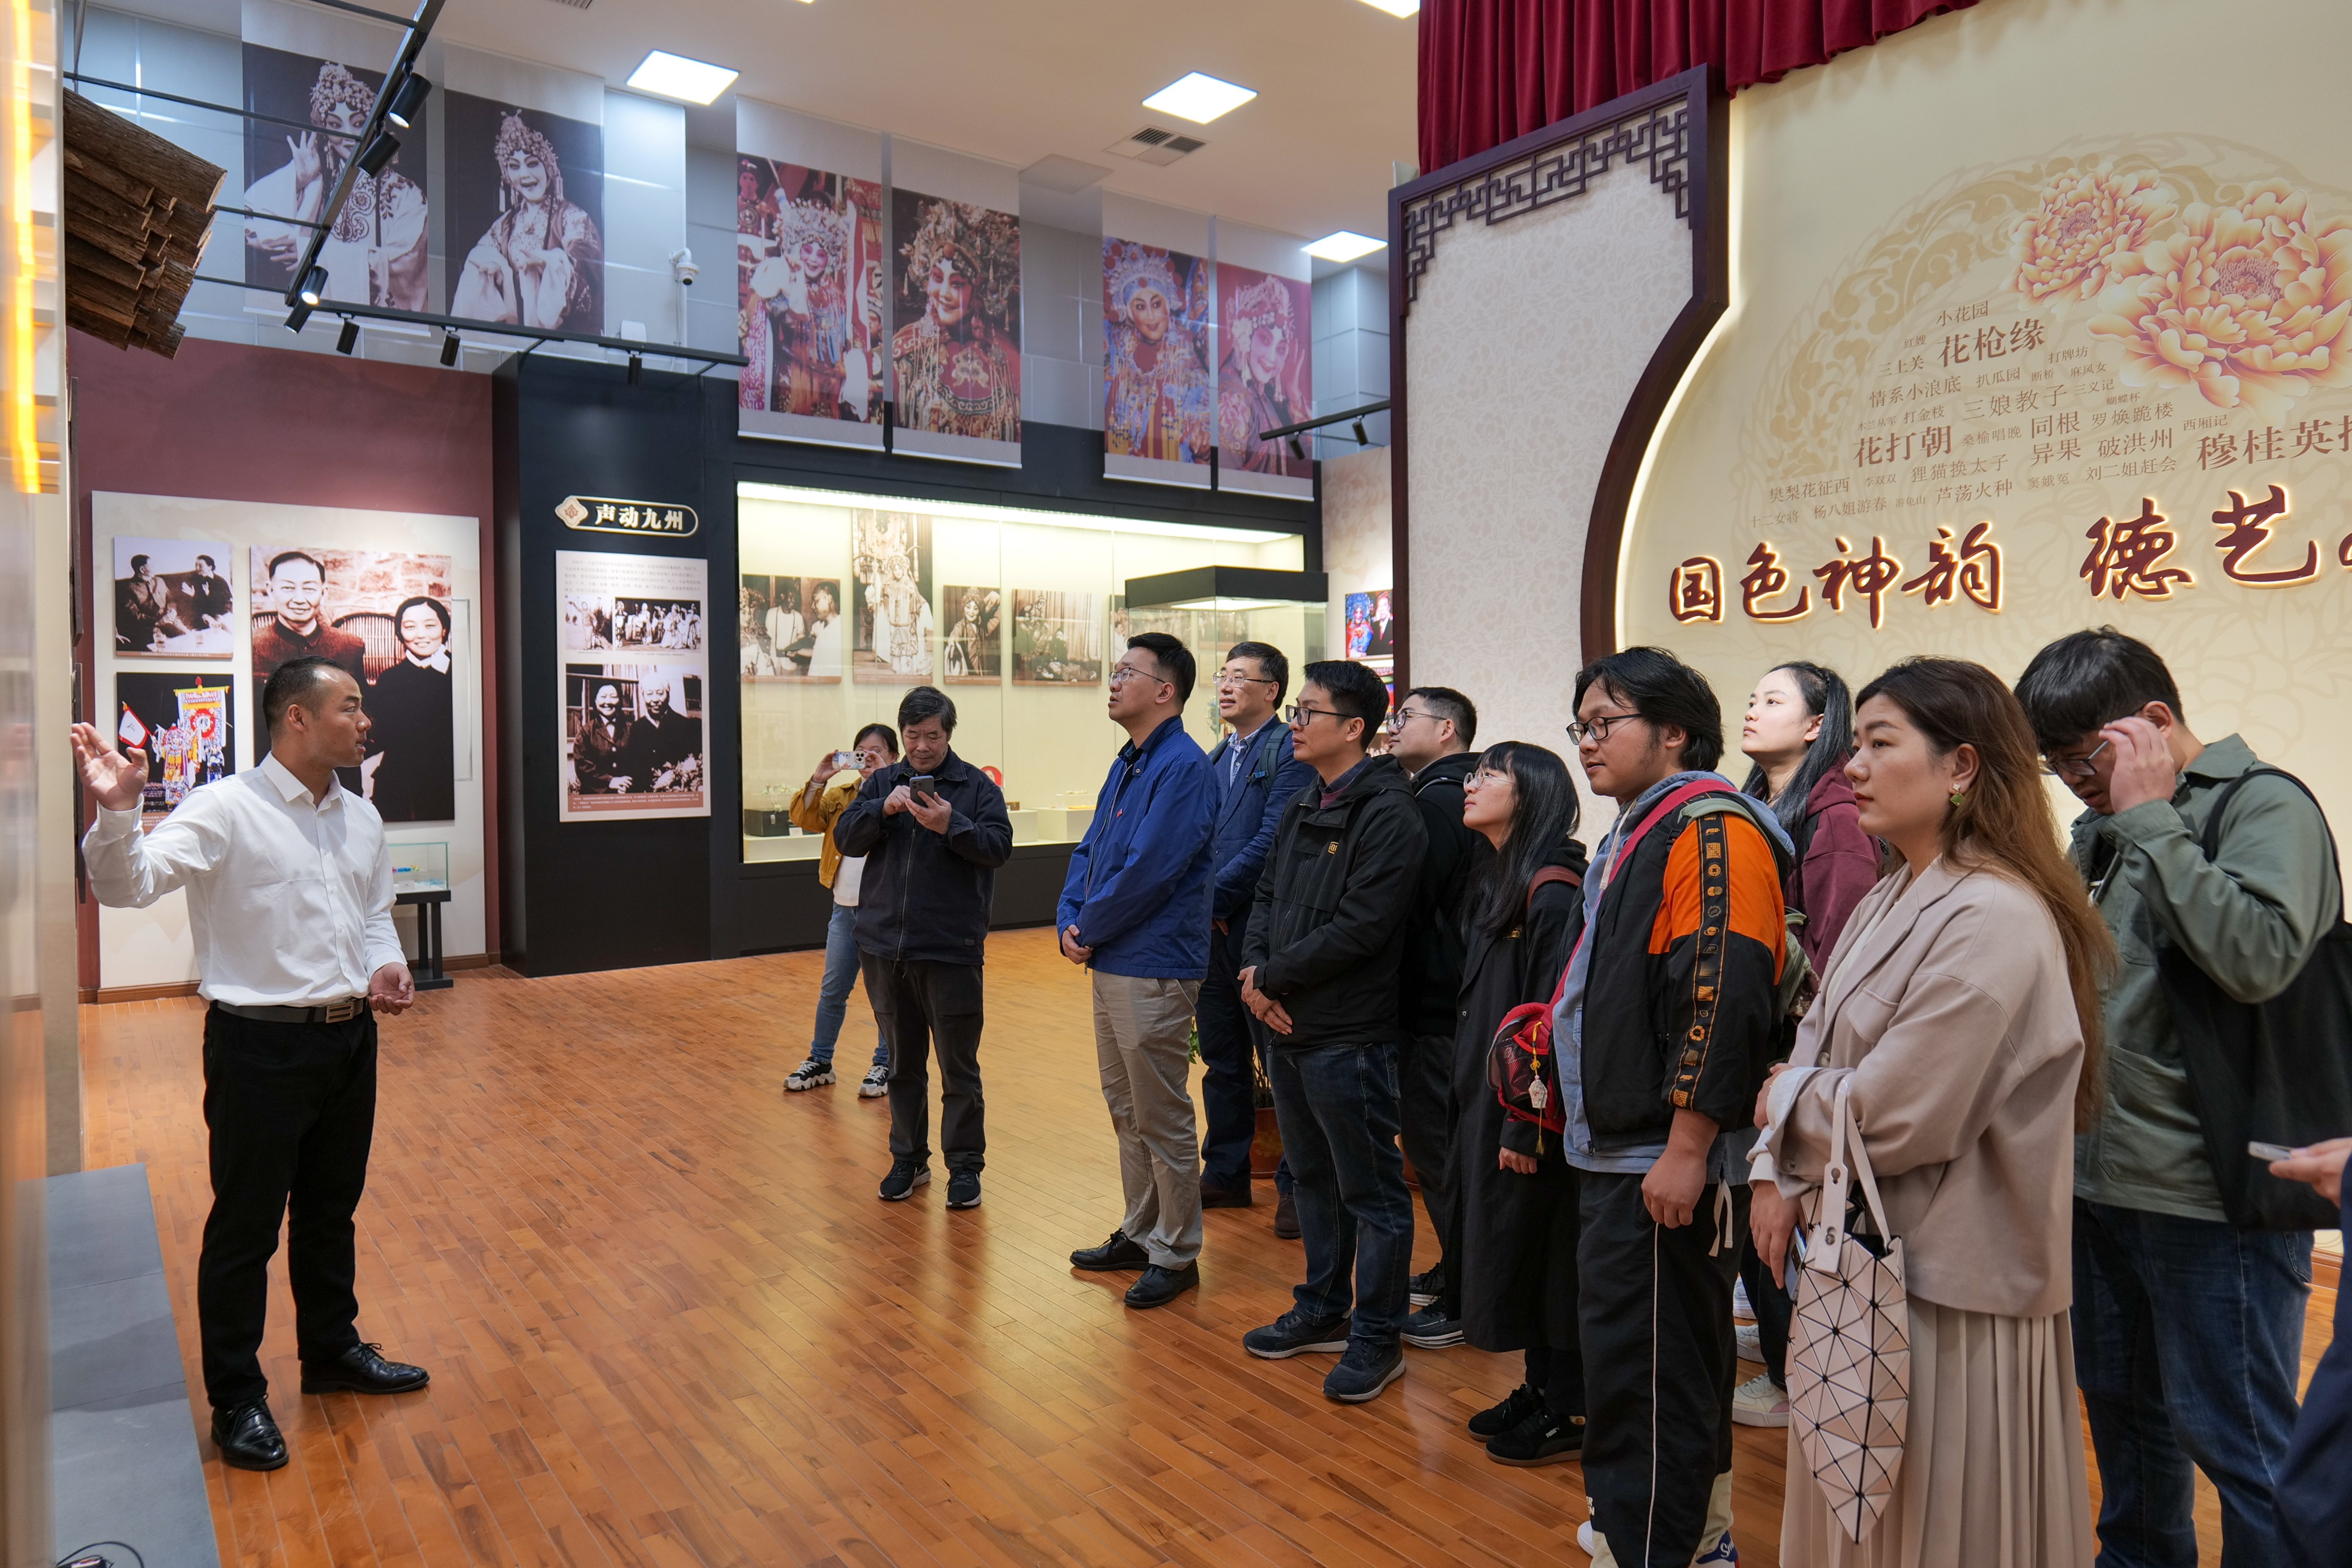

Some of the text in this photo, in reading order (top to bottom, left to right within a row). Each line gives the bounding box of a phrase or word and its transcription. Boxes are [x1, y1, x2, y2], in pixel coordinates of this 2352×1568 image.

[1936, 300, 1989, 327] 小花园
[1904, 334, 1926, 349] 红嫂
[1937, 318, 2045, 367] 花枪缘
[1878, 355, 1924, 377] 三上关
[2048, 346, 2088, 364] 打牌坊
[1976, 367, 2021, 388] 扒瓜园
[2031, 369, 2055, 382] 断桥
[2070, 362, 2107, 378] 麻风女
[1870, 375, 1961, 408] 情系小浪底
[2073, 378, 2115, 396] 三义记
[1963, 384, 2067, 421] 三娘教子
[2106, 392, 2141, 406] 蝴蝶杯
[1857, 415, 1897, 431] 木兰从军
[1903, 405, 1945, 424] 打金枝
[2031, 411, 2082, 439] 同根
[2091, 401, 2174, 431] 罗焕跪楼
[2183, 414, 2228, 432] 西厢记
[1853, 424, 1952, 468] 花打朝
[1961, 425, 2022, 447] 桑榆唱晚
[2096, 427, 2173, 459] 破洪州
[2030, 437, 2082, 467] 异果
[1910, 453, 2008, 483] 狸猫换太子
[2085, 455, 2177, 482] 刘二姐赶会
[1768, 477, 1851, 504] 樊梨花征西
[1864, 474, 1897, 488] 李双双
[1935, 478, 2013, 506] 芦荡火种
[2027, 472, 2070, 490] 窦娥冤
[1813, 496, 1887, 520] 杨八姐游春
[1895, 494, 1926, 508] 游龟山
[595, 504, 683, 531] 声动九州
[1749, 510, 1800, 528] 十二女将
[1669, 484, 2352, 629] 国色神韵 德艺
